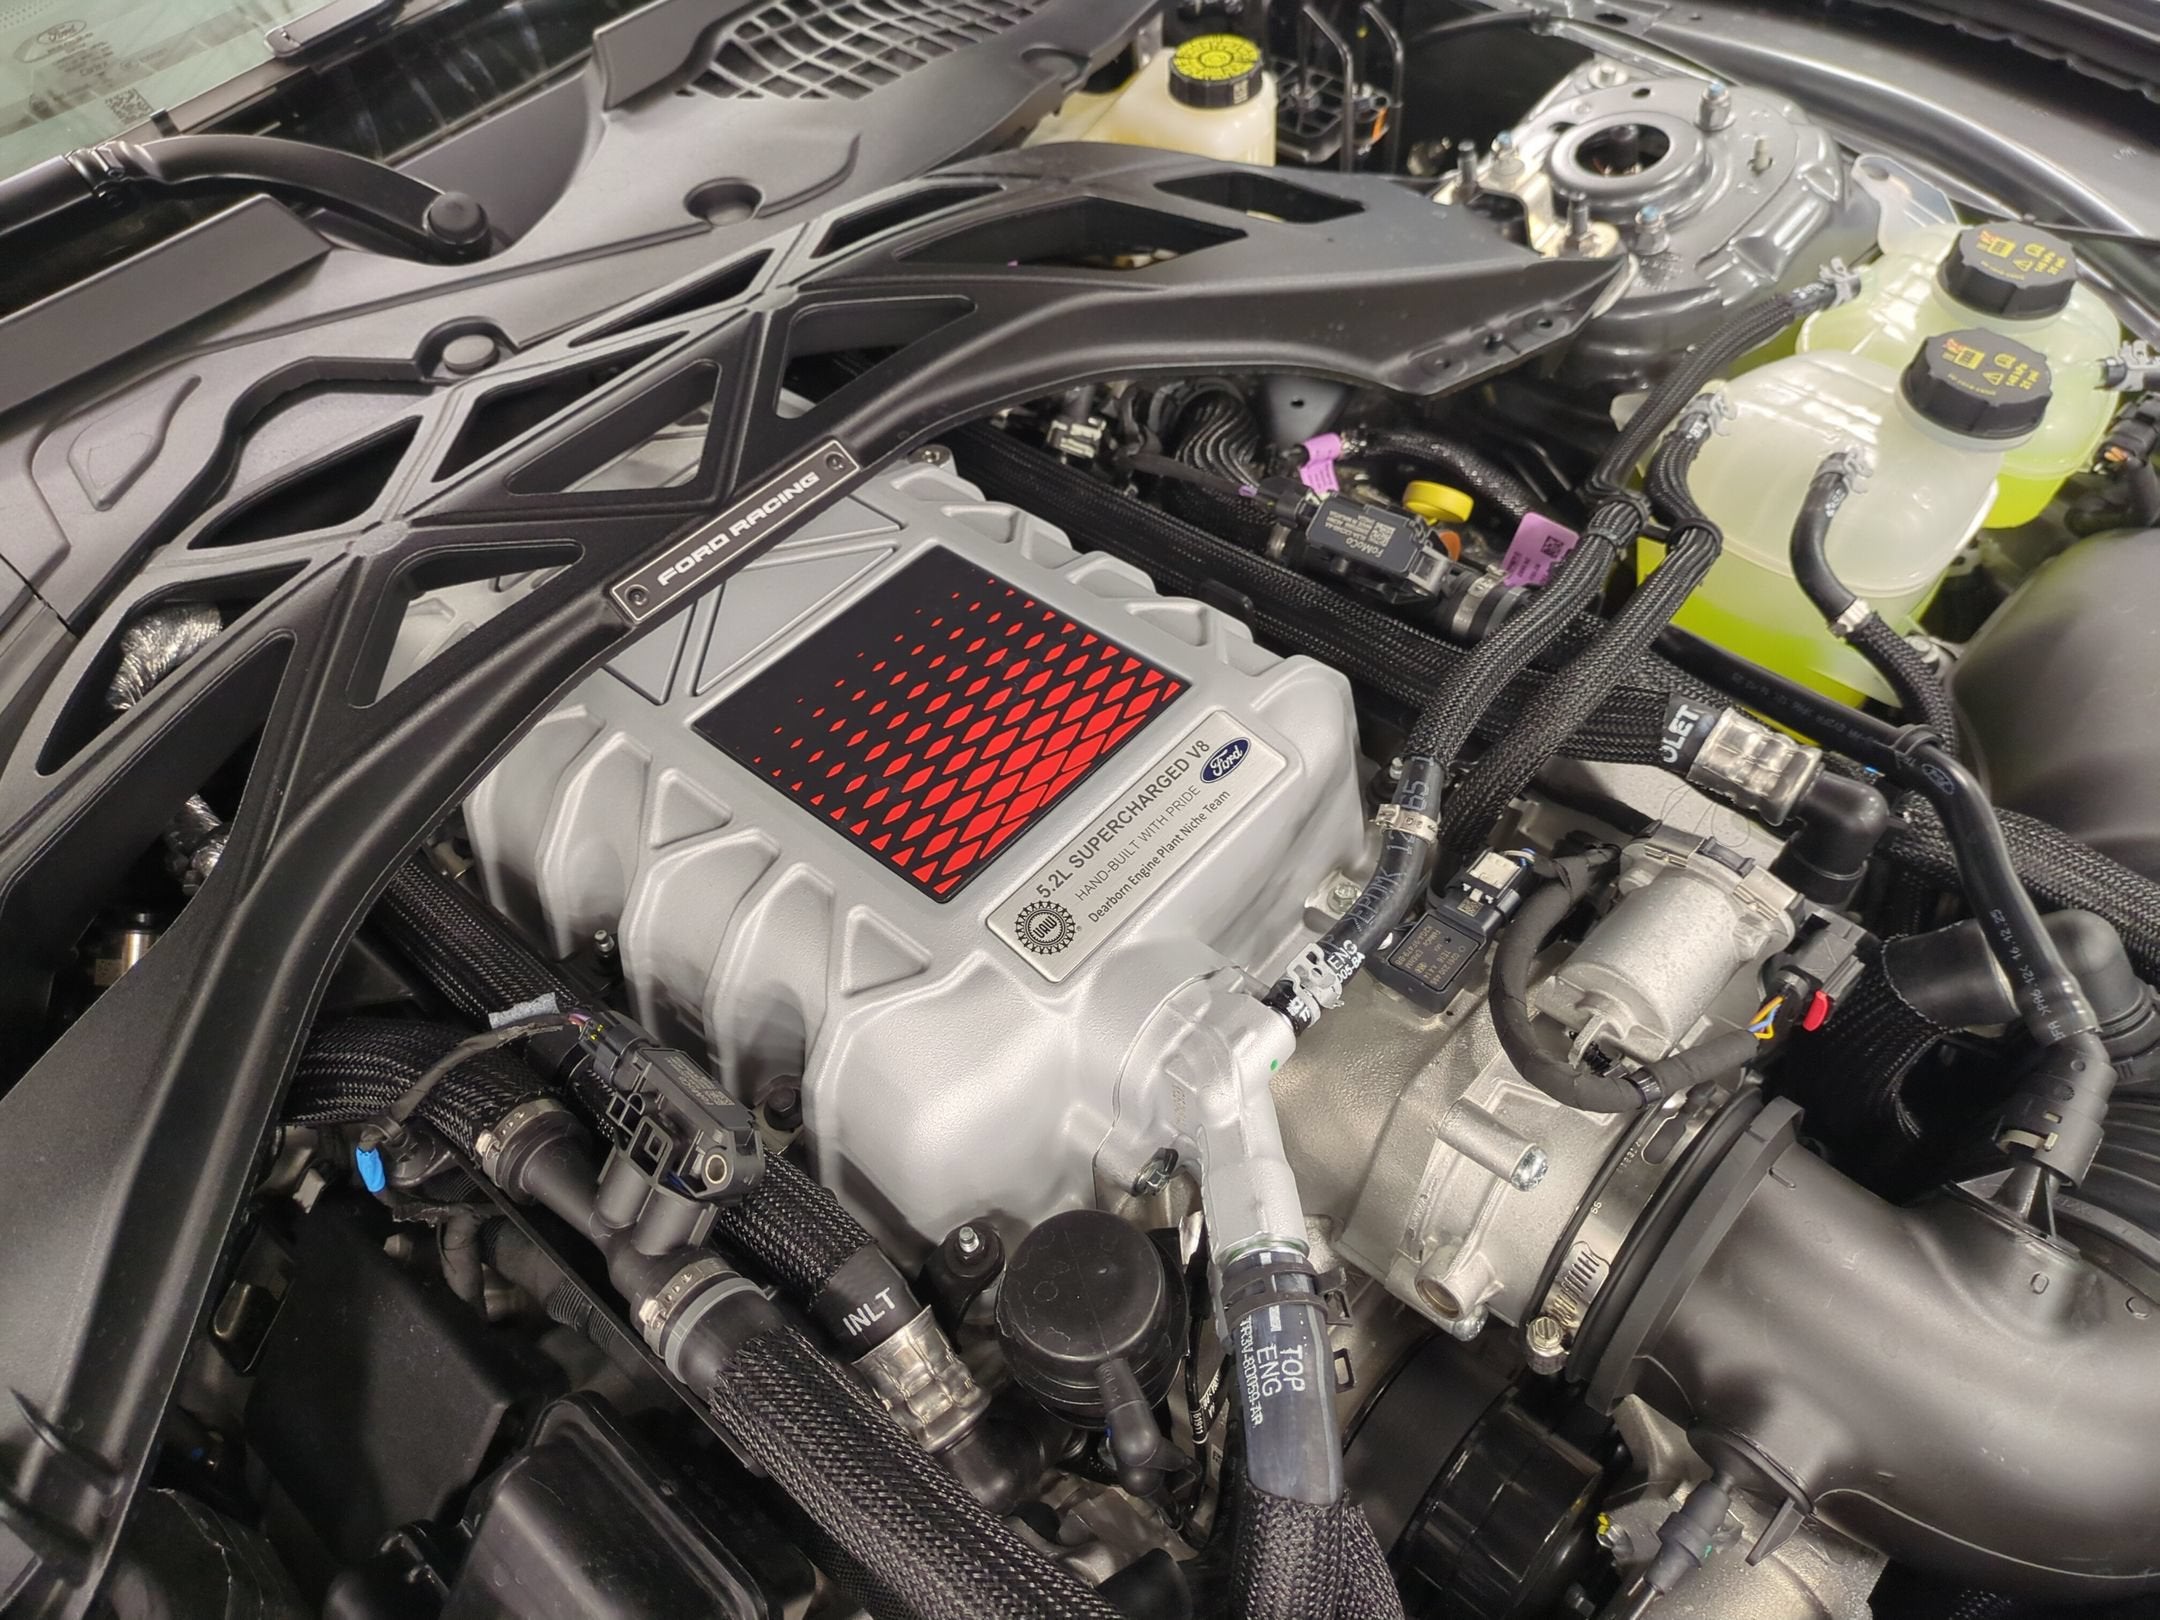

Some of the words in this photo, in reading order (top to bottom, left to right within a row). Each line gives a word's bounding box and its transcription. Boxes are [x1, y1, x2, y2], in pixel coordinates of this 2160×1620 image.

[657, 533, 730, 586] FORD
[729, 471, 820, 536] RACING
[1345, 537, 1385, 558] FoMoCo
[1036, 870, 1073, 898] 5.2L
[1068, 758, 1190, 869] SUPERCHARGED
[1187, 740, 1210, 760] V8
[1074, 839, 1140, 901] HAND-BUILT
[1137, 814, 1168, 843] WITH
[1166, 784, 1201, 818] PRIDE
[1088, 876, 1132, 923] Dearborn
[1127, 851, 1161, 884] Engine
[1157, 832, 1185, 859] Plant
[1181, 812, 1207, 838] Niche
[1202, 789, 1231, 815] Team
[1033, 916, 1058, 940] UAW
[1327, 939, 1358, 971] ENG
[843, 1286, 896, 1337] INLT
[1256, 1342, 1283, 1397] ENG
[1279, 1345, 1306, 1392] TOP
